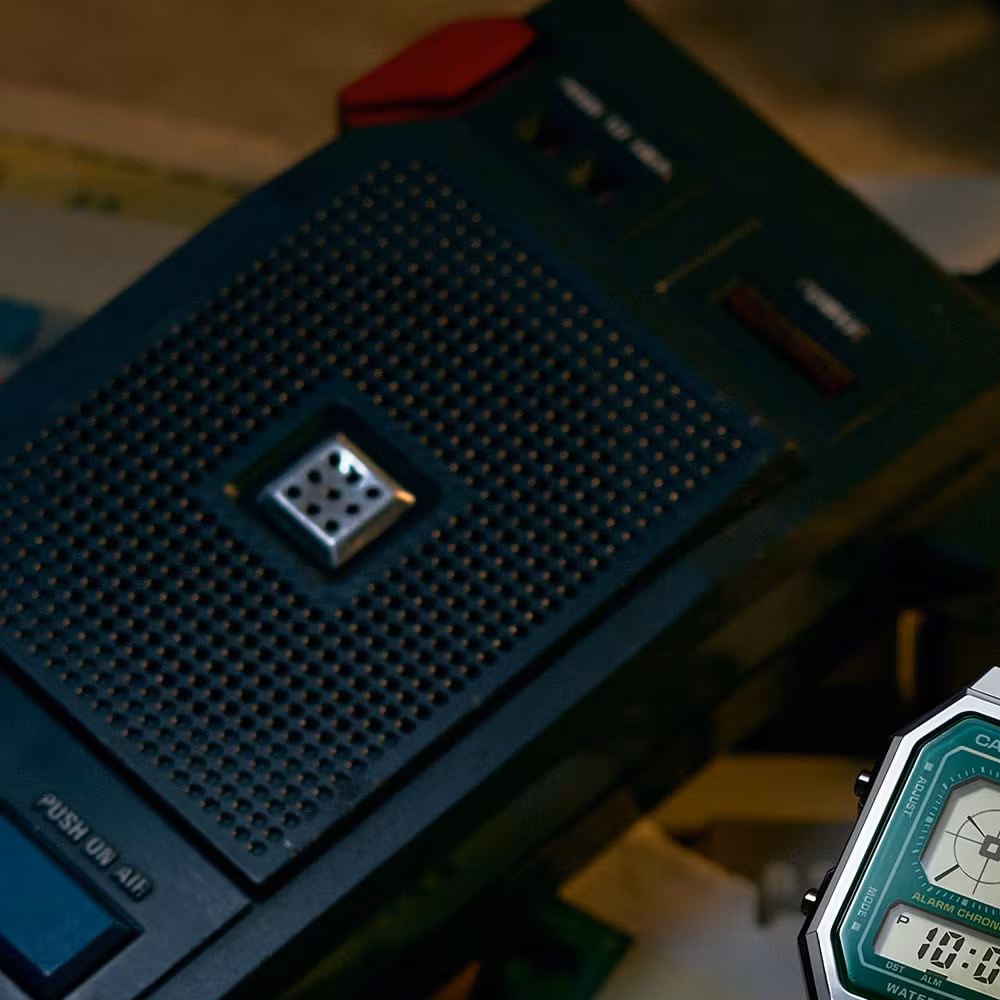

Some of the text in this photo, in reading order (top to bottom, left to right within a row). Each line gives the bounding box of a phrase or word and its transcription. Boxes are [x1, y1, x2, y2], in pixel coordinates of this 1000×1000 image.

[904, 776, 927, 818] ADJUST
[36, 792, 151, 898] PUSH ON AIR
[858, 887, 878, 918] MODE
[911, 891, 954, 914] ALARM
[896, 914, 910, 925] P
[885, 962, 904, 974] DST
[920, 974, 943, 987] ALM
